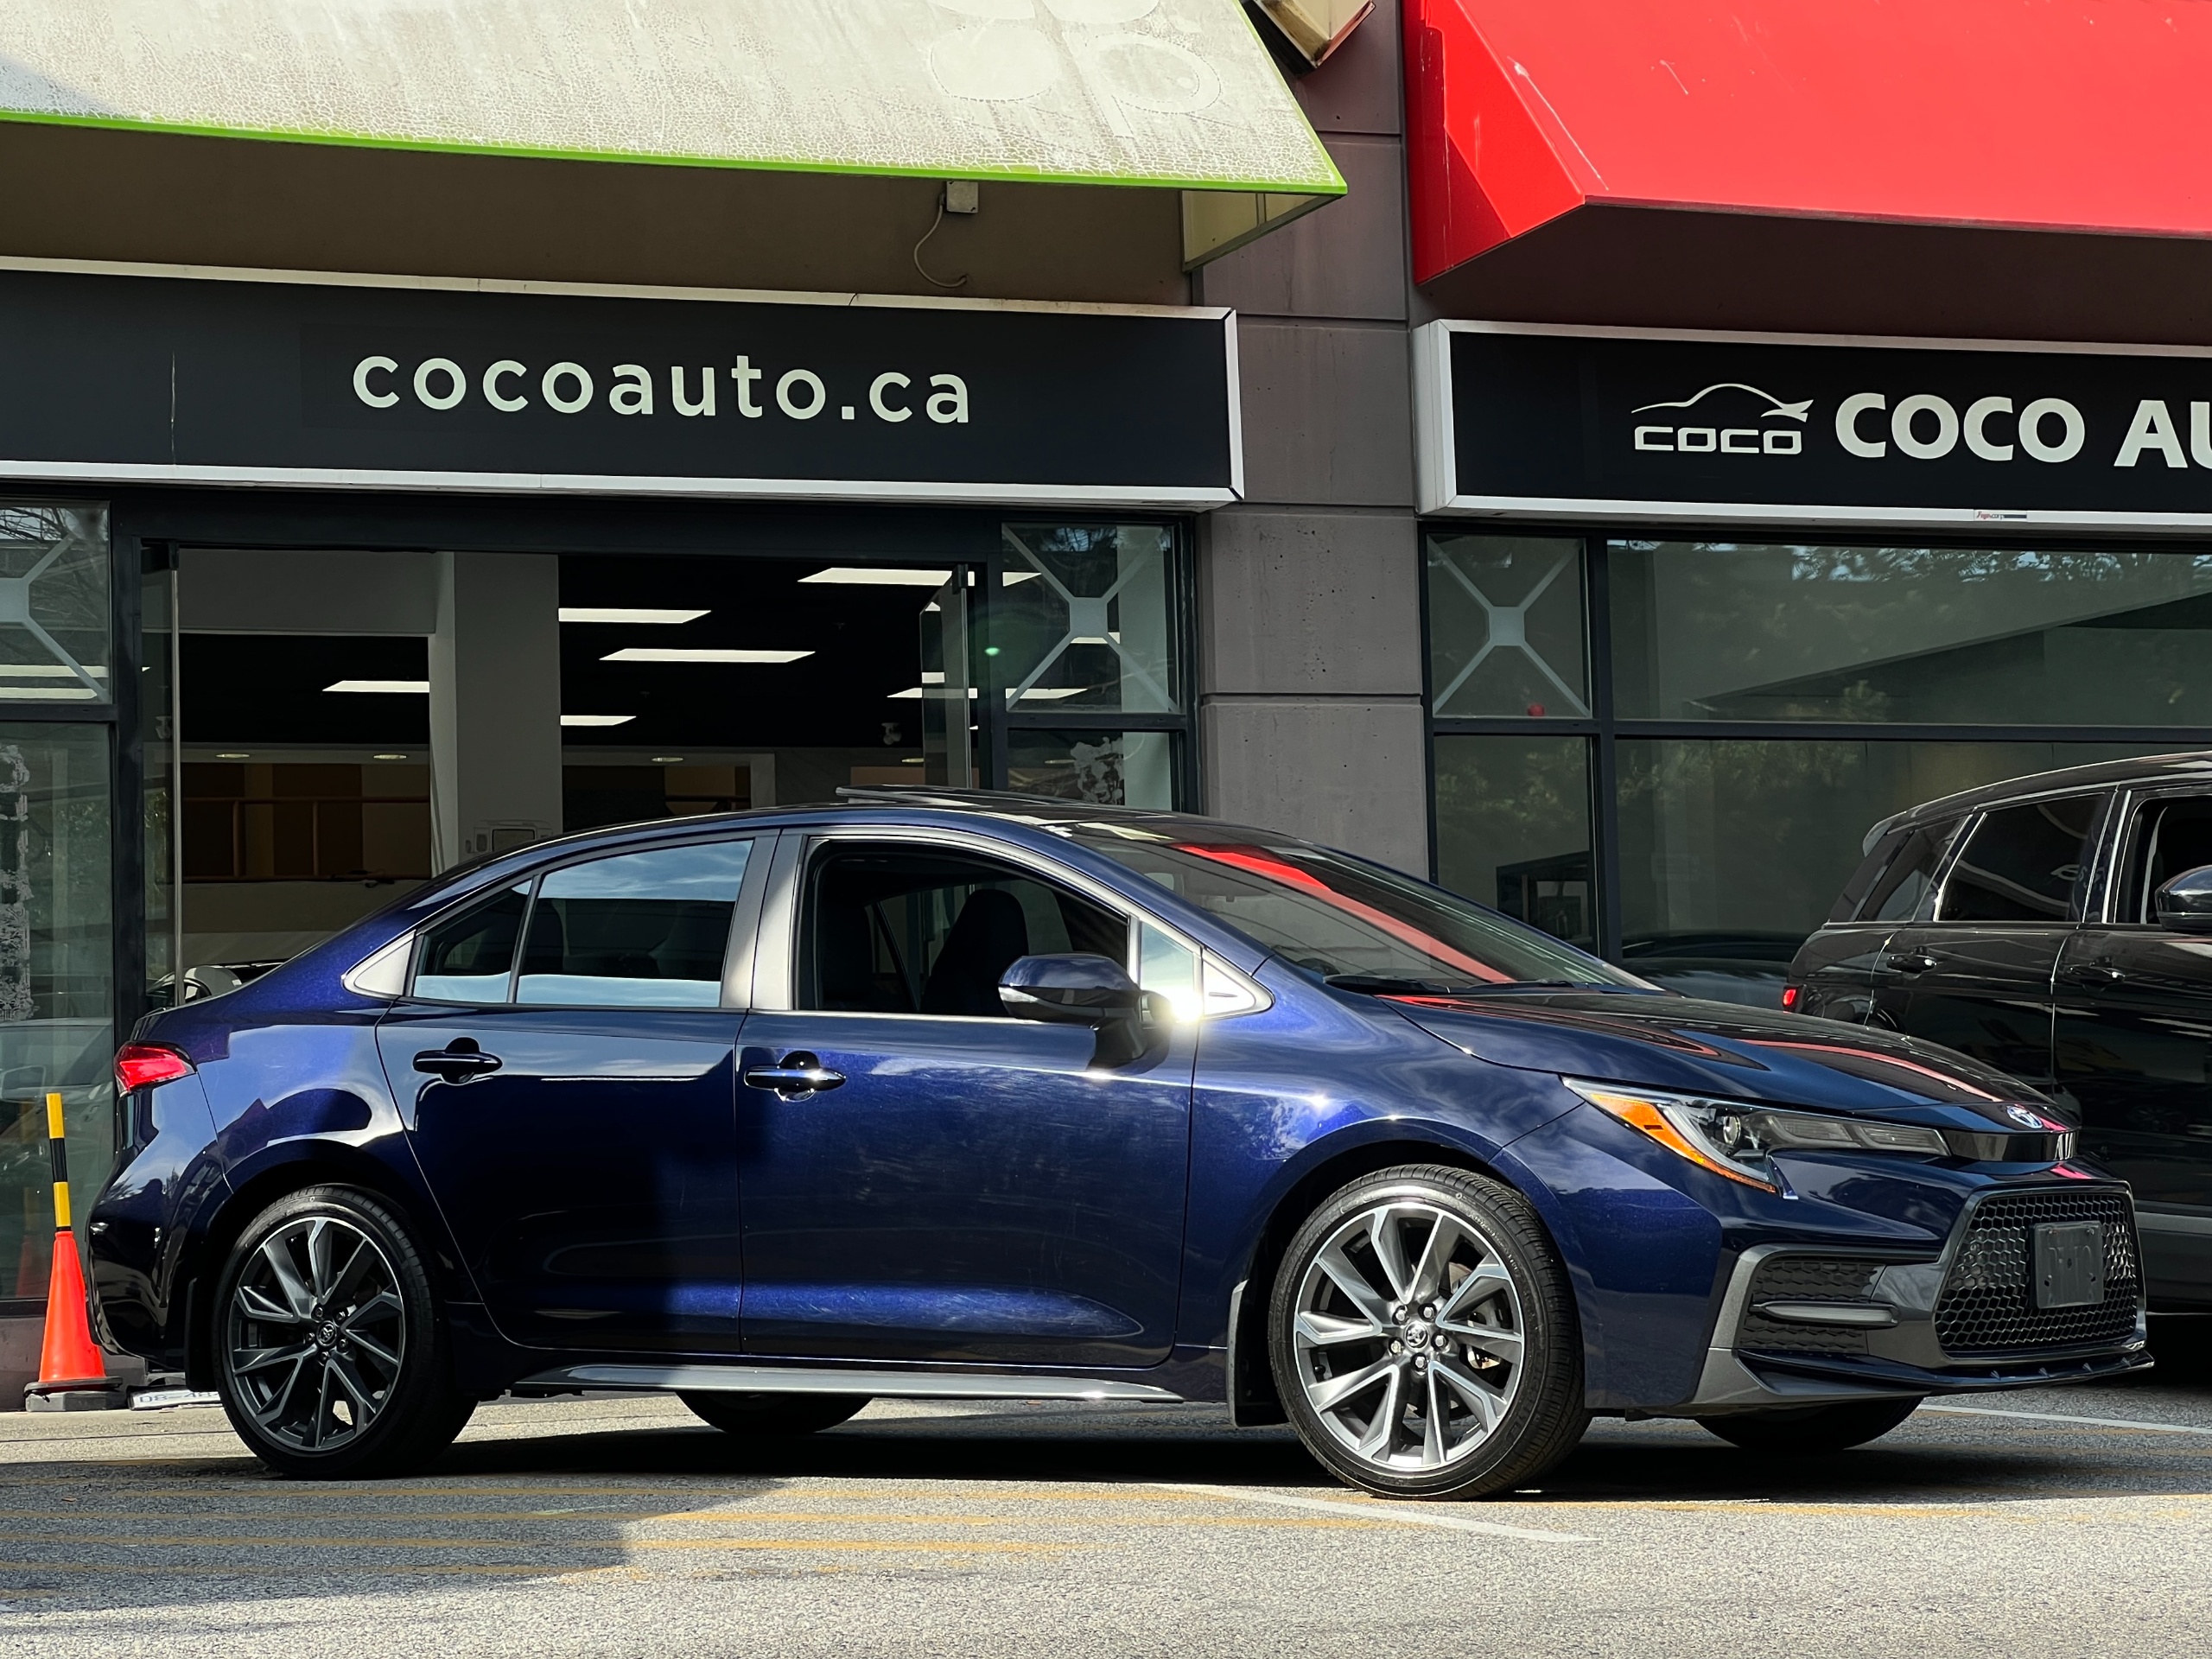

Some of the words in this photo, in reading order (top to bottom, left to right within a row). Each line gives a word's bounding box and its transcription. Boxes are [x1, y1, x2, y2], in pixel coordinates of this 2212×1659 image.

[353, 355, 969, 423] cocoauto.ca
[1634, 425, 1802, 455] COCO
[1835, 392, 2086, 463] COCO
